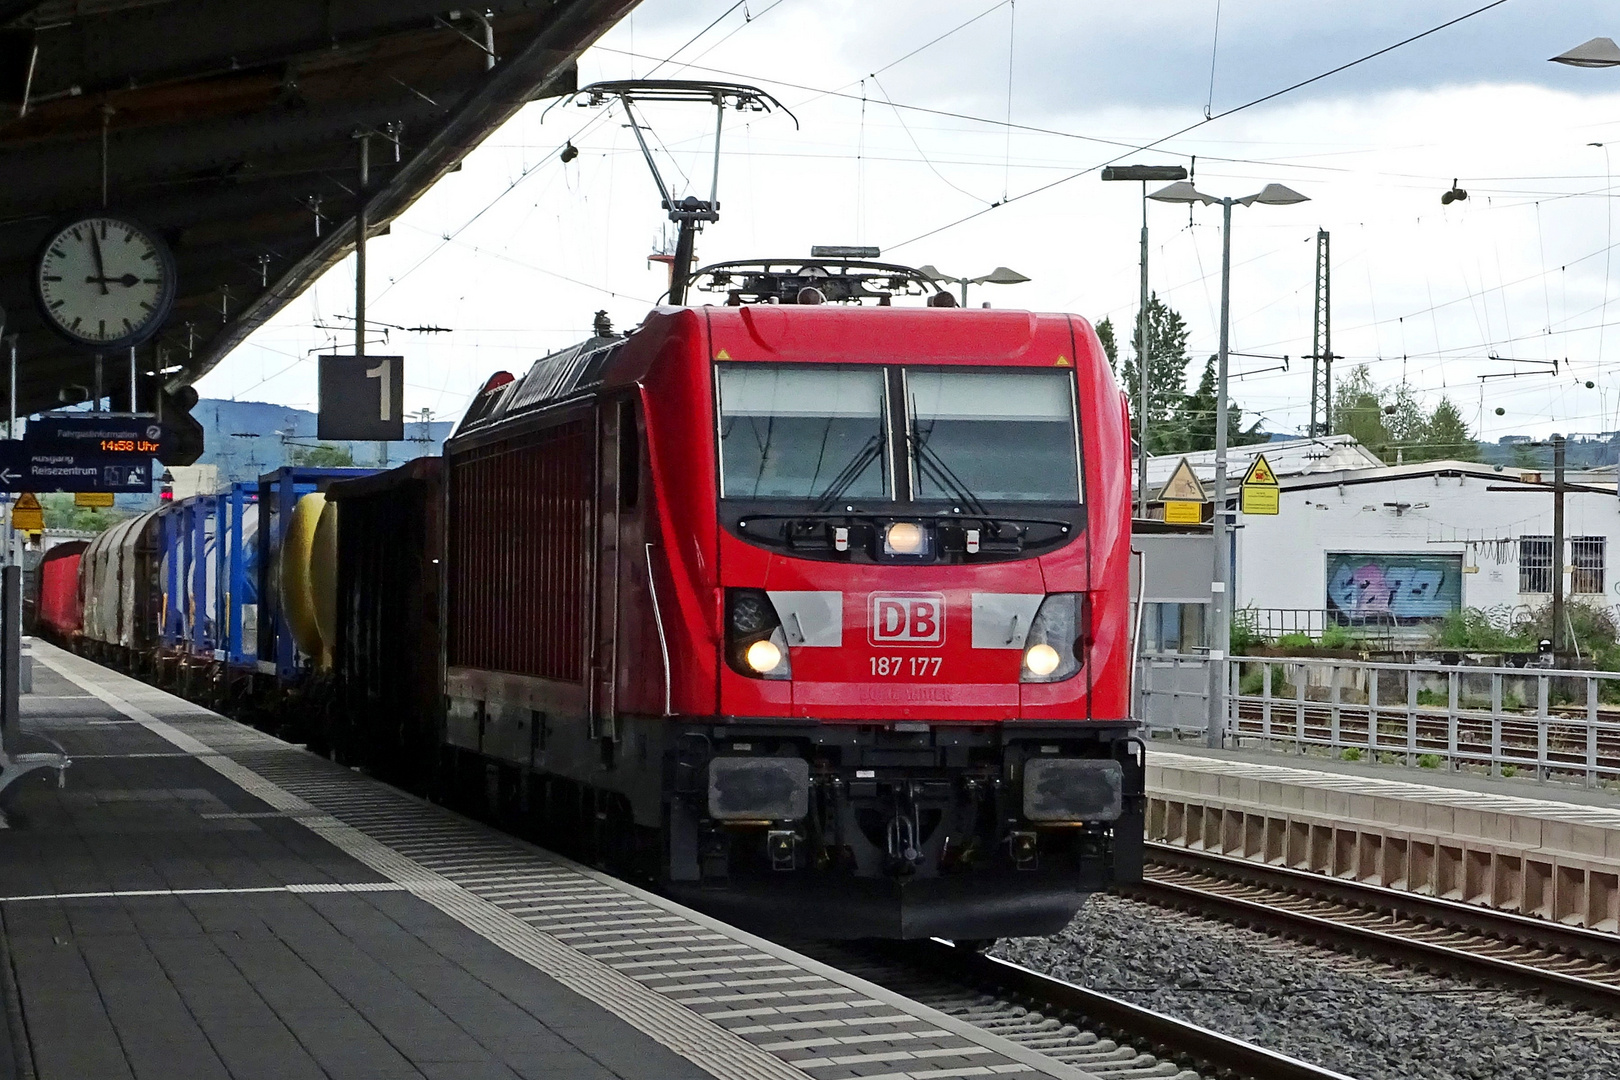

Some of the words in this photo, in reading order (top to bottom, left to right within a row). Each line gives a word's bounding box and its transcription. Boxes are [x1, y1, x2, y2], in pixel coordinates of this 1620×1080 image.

[366, 360, 392, 421] 1
[100, 440, 134, 451] 14:58
[137, 441, 159, 452] Uhr
[31, 466, 98, 476] Reisezentrum
[878, 601, 937, 638] DB
[869, 656, 903, 677] 187
[909, 656, 943, 677] 177
